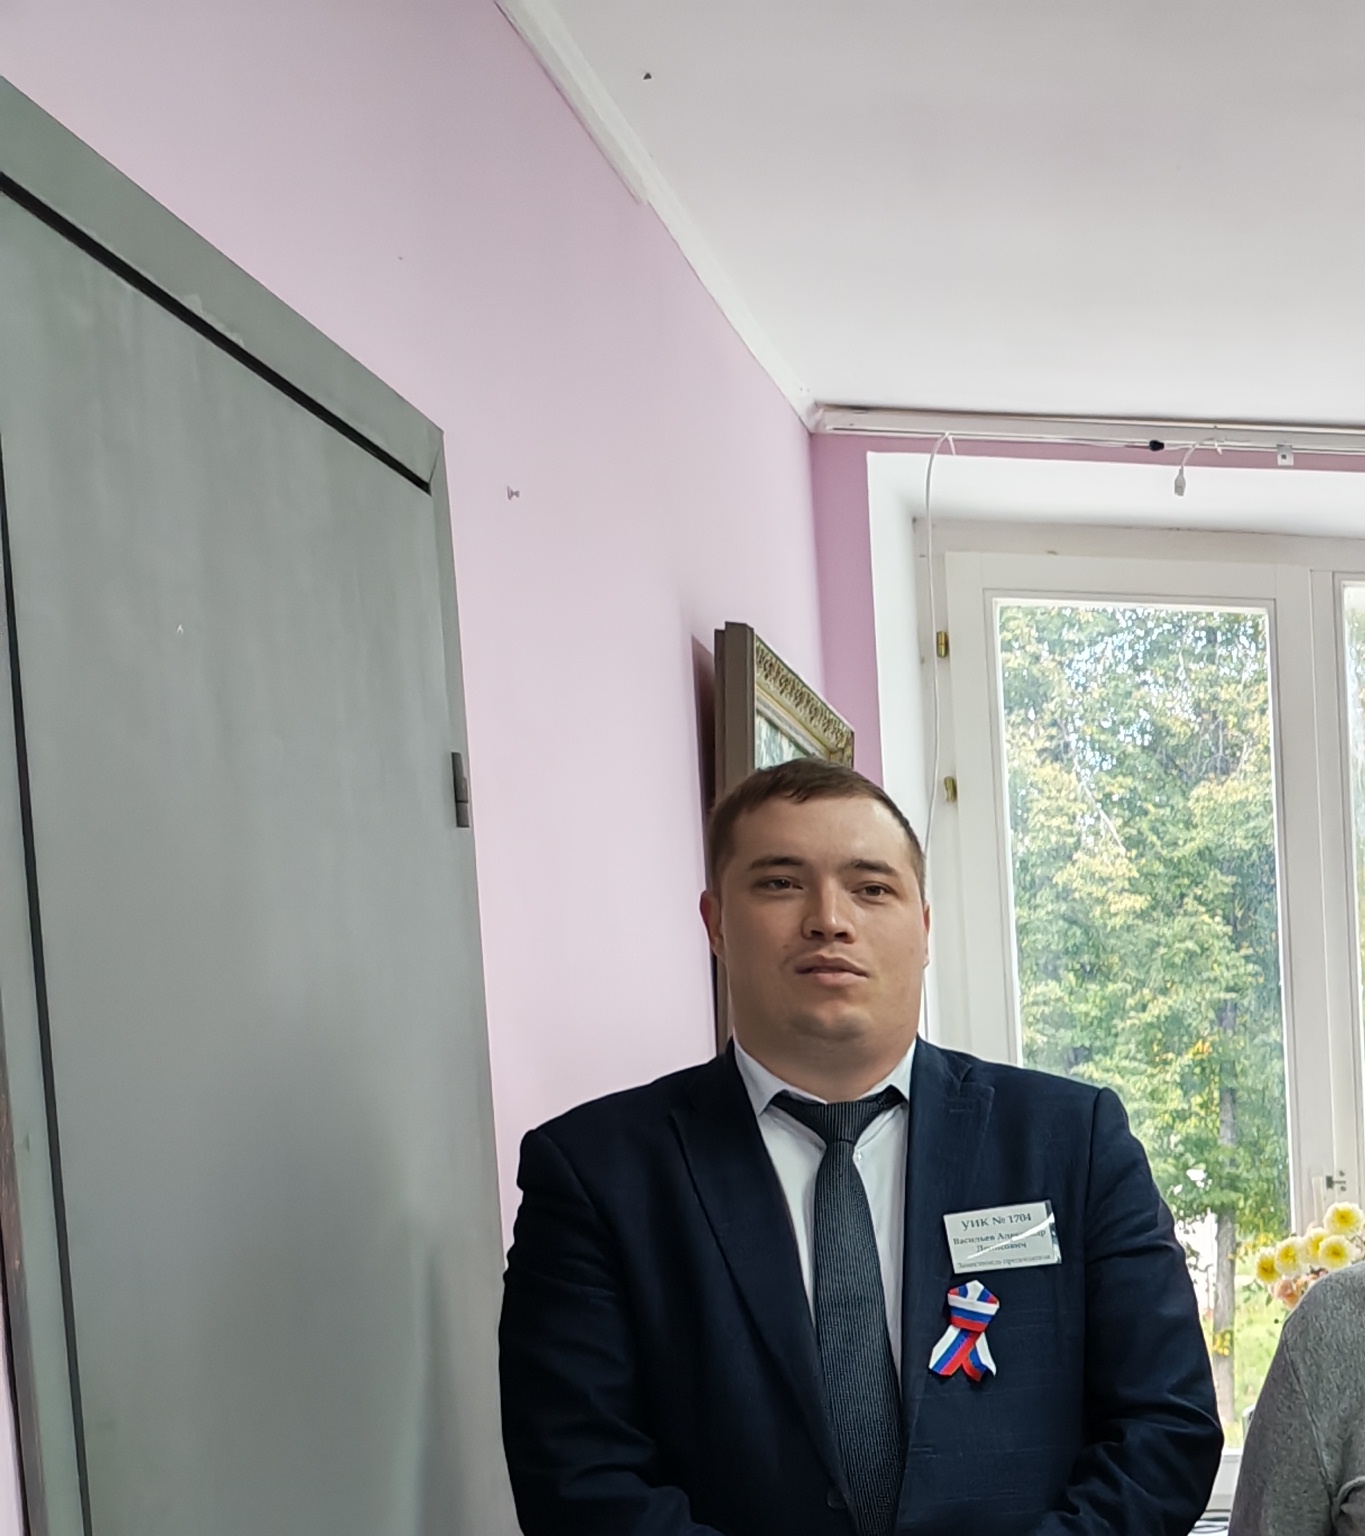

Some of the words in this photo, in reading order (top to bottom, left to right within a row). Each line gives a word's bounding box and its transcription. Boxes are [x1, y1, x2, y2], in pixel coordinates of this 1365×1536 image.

[961, 1218, 989, 1231] УИК
[993, 1216, 1006, 1226] №
[1009, 1213, 1032, 1224] 1704
